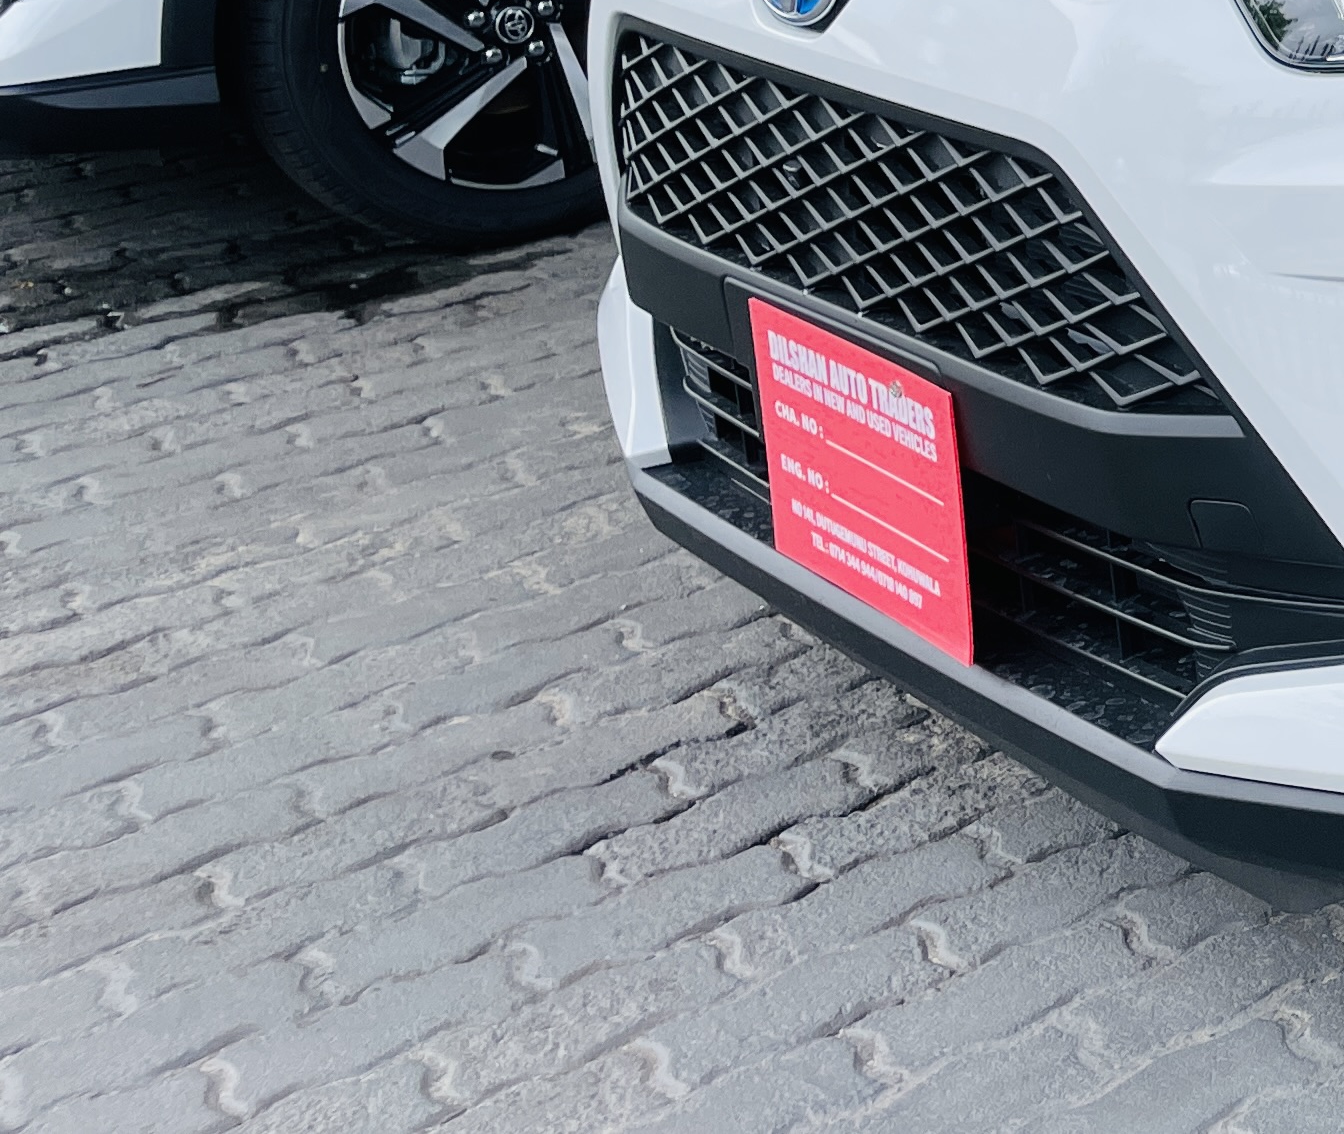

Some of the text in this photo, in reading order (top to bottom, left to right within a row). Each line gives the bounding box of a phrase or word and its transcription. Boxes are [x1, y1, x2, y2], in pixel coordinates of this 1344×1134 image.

[767, 329, 936, 440] DILSHAN AUTO TRADERS
[772, 361, 938, 463] DEALERS IN NEW AND USED VEHICLES
[775, 399, 801, 427] CHA.
[780, 453, 806, 481] ENG.
